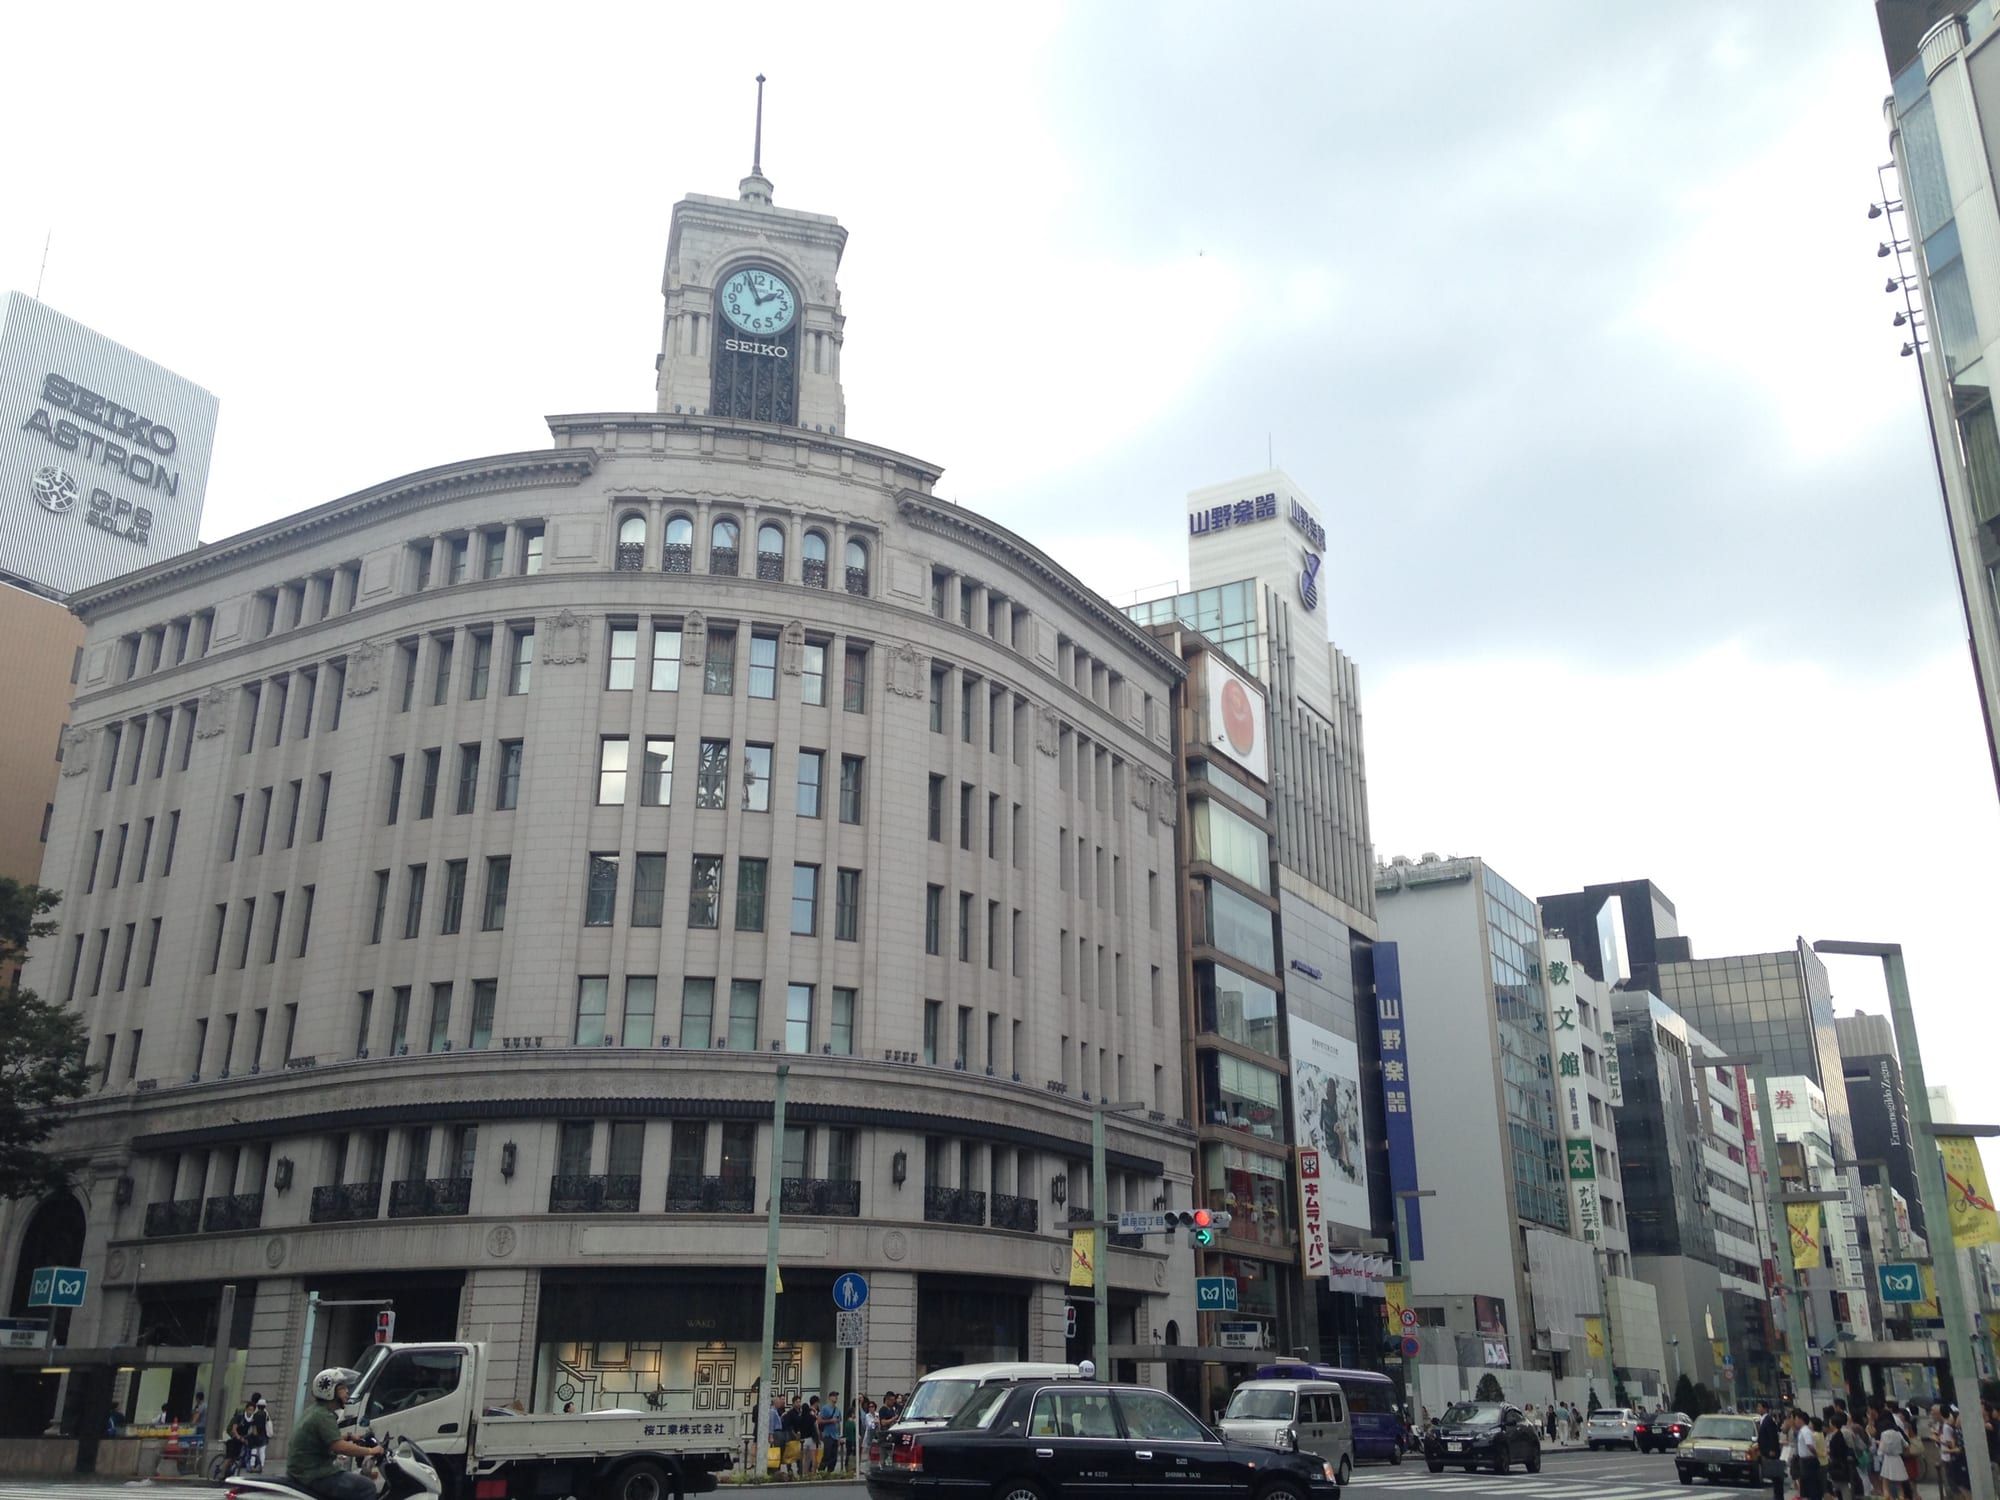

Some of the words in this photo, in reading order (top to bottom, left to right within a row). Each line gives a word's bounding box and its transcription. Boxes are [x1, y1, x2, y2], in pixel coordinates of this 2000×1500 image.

[732, 283, 743, 293] 10
[754, 275, 765, 286] 12
[769, 280, 773, 290] 1
[728, 292, 737, 303] 9
[776, 289, 785, 300] 2
[731, 304, 741, 315] 8
[779, 301, 788, 311] 3
[742, 313, 751, 324] 7
[752, 318, 761, 329] 6
[765, 317, 773, 328] 5
[774, 311, 784, 321] 4
[725, 339, 788, 357] SEIKO
[42, 372, 177, 456] SEIKO
[22, 408, 179, 497] ASTRON
[91, 487, 153, 530] GPS
[1190, 493, 1276, 537] 山野楽器
[86, 510, 149, 547] SOLAR
[1291, 495, 1327, 553] 山野楽器
[1549, 960, 1580, 1078] 教文館
[1380, 999, 1407, 1114] 山野楽器
[1602, 1031, 1622, 1100] 教文館ビル
[1880, 1061, 1891, 1088] Zegna
[1883, 1089, 1901, 1146] Ermenegildo
[1569, 1145, 1592, 1174] 本
[1304, 1183, 1324, 1270] キムラヤのパン
[686, 1319, 717, 1329] WAKO
[644, 1423, 725, 1436] 桜工業株式会社
